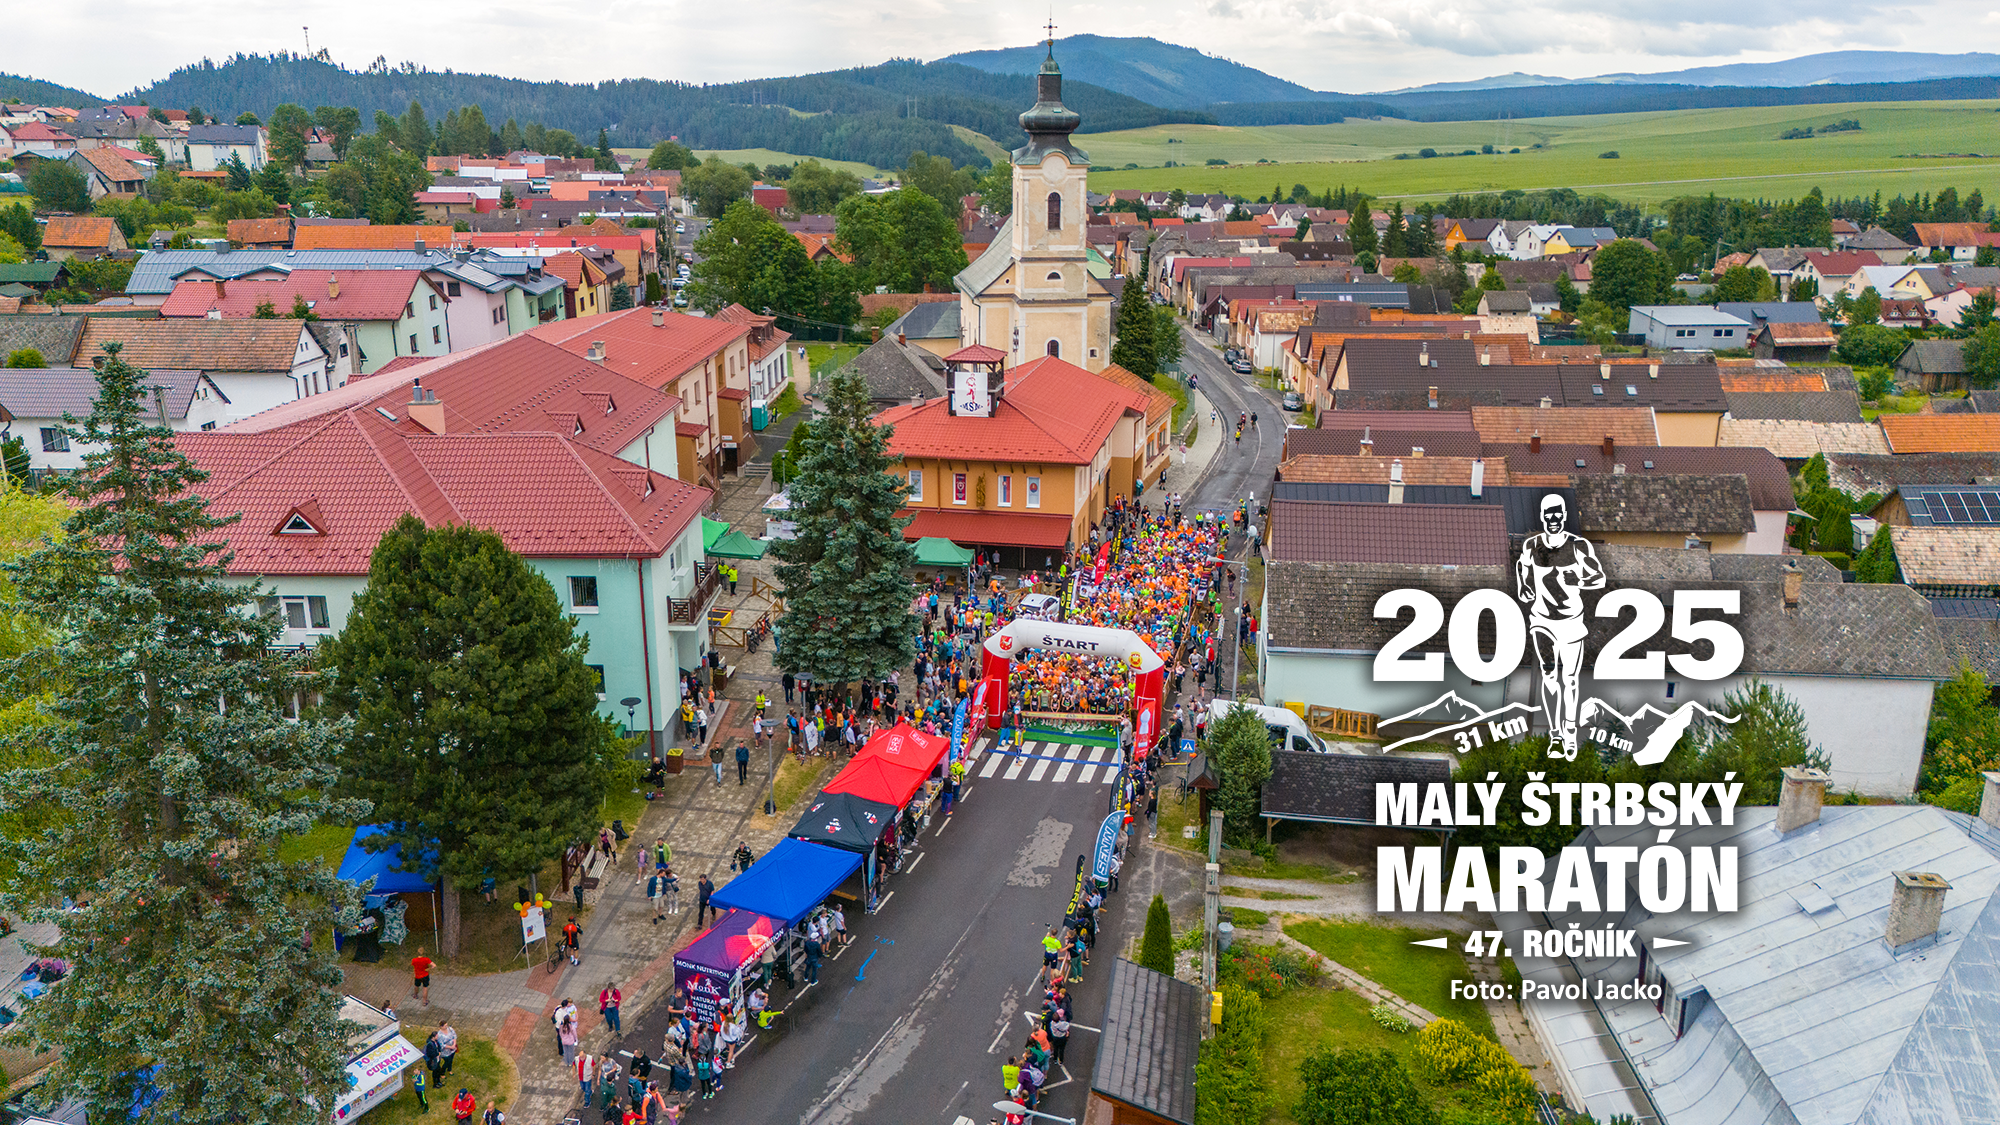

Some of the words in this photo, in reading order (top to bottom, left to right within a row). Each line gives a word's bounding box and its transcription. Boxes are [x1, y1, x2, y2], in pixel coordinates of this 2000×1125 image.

[1042, 634, 1099, 651] ŠTART
[676, 960, 696, 969] MONK
[697, 965, 730, 979] NUTRITION
[698, 1015, 712, 1023] AND
[355, 1038, 400, 1068] POPCORN
[380, 1059, 407, 1076] VATA
